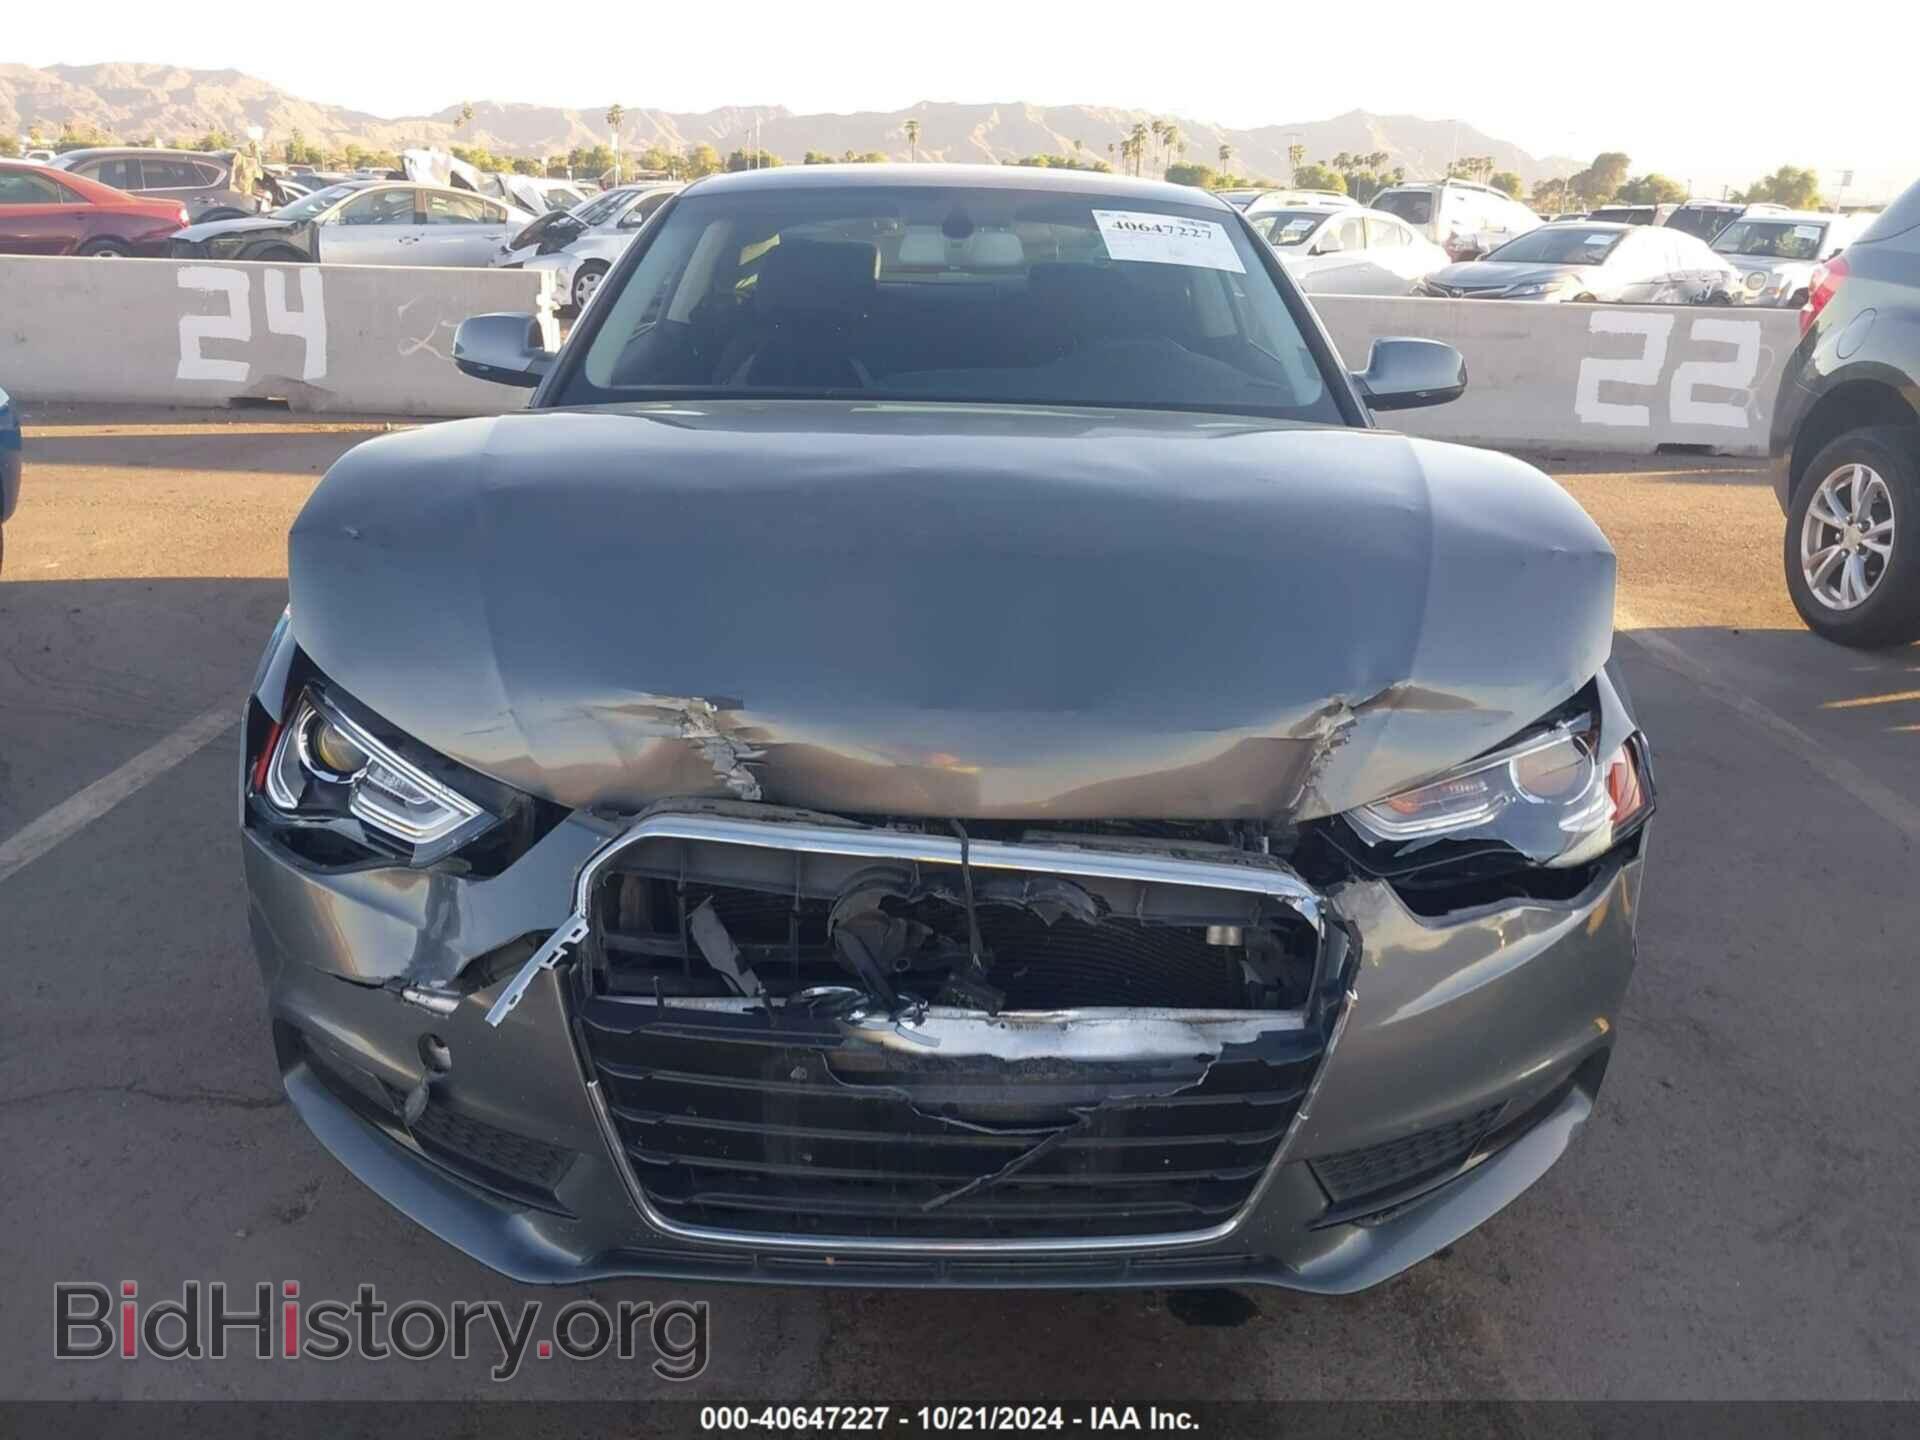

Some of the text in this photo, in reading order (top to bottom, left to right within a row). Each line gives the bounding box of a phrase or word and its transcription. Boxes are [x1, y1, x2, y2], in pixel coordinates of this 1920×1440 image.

[1111, 219, 1213, 240] 40647227
[176, 266, 327, 381] 24
[1574, 310, 1762, 428] 22
